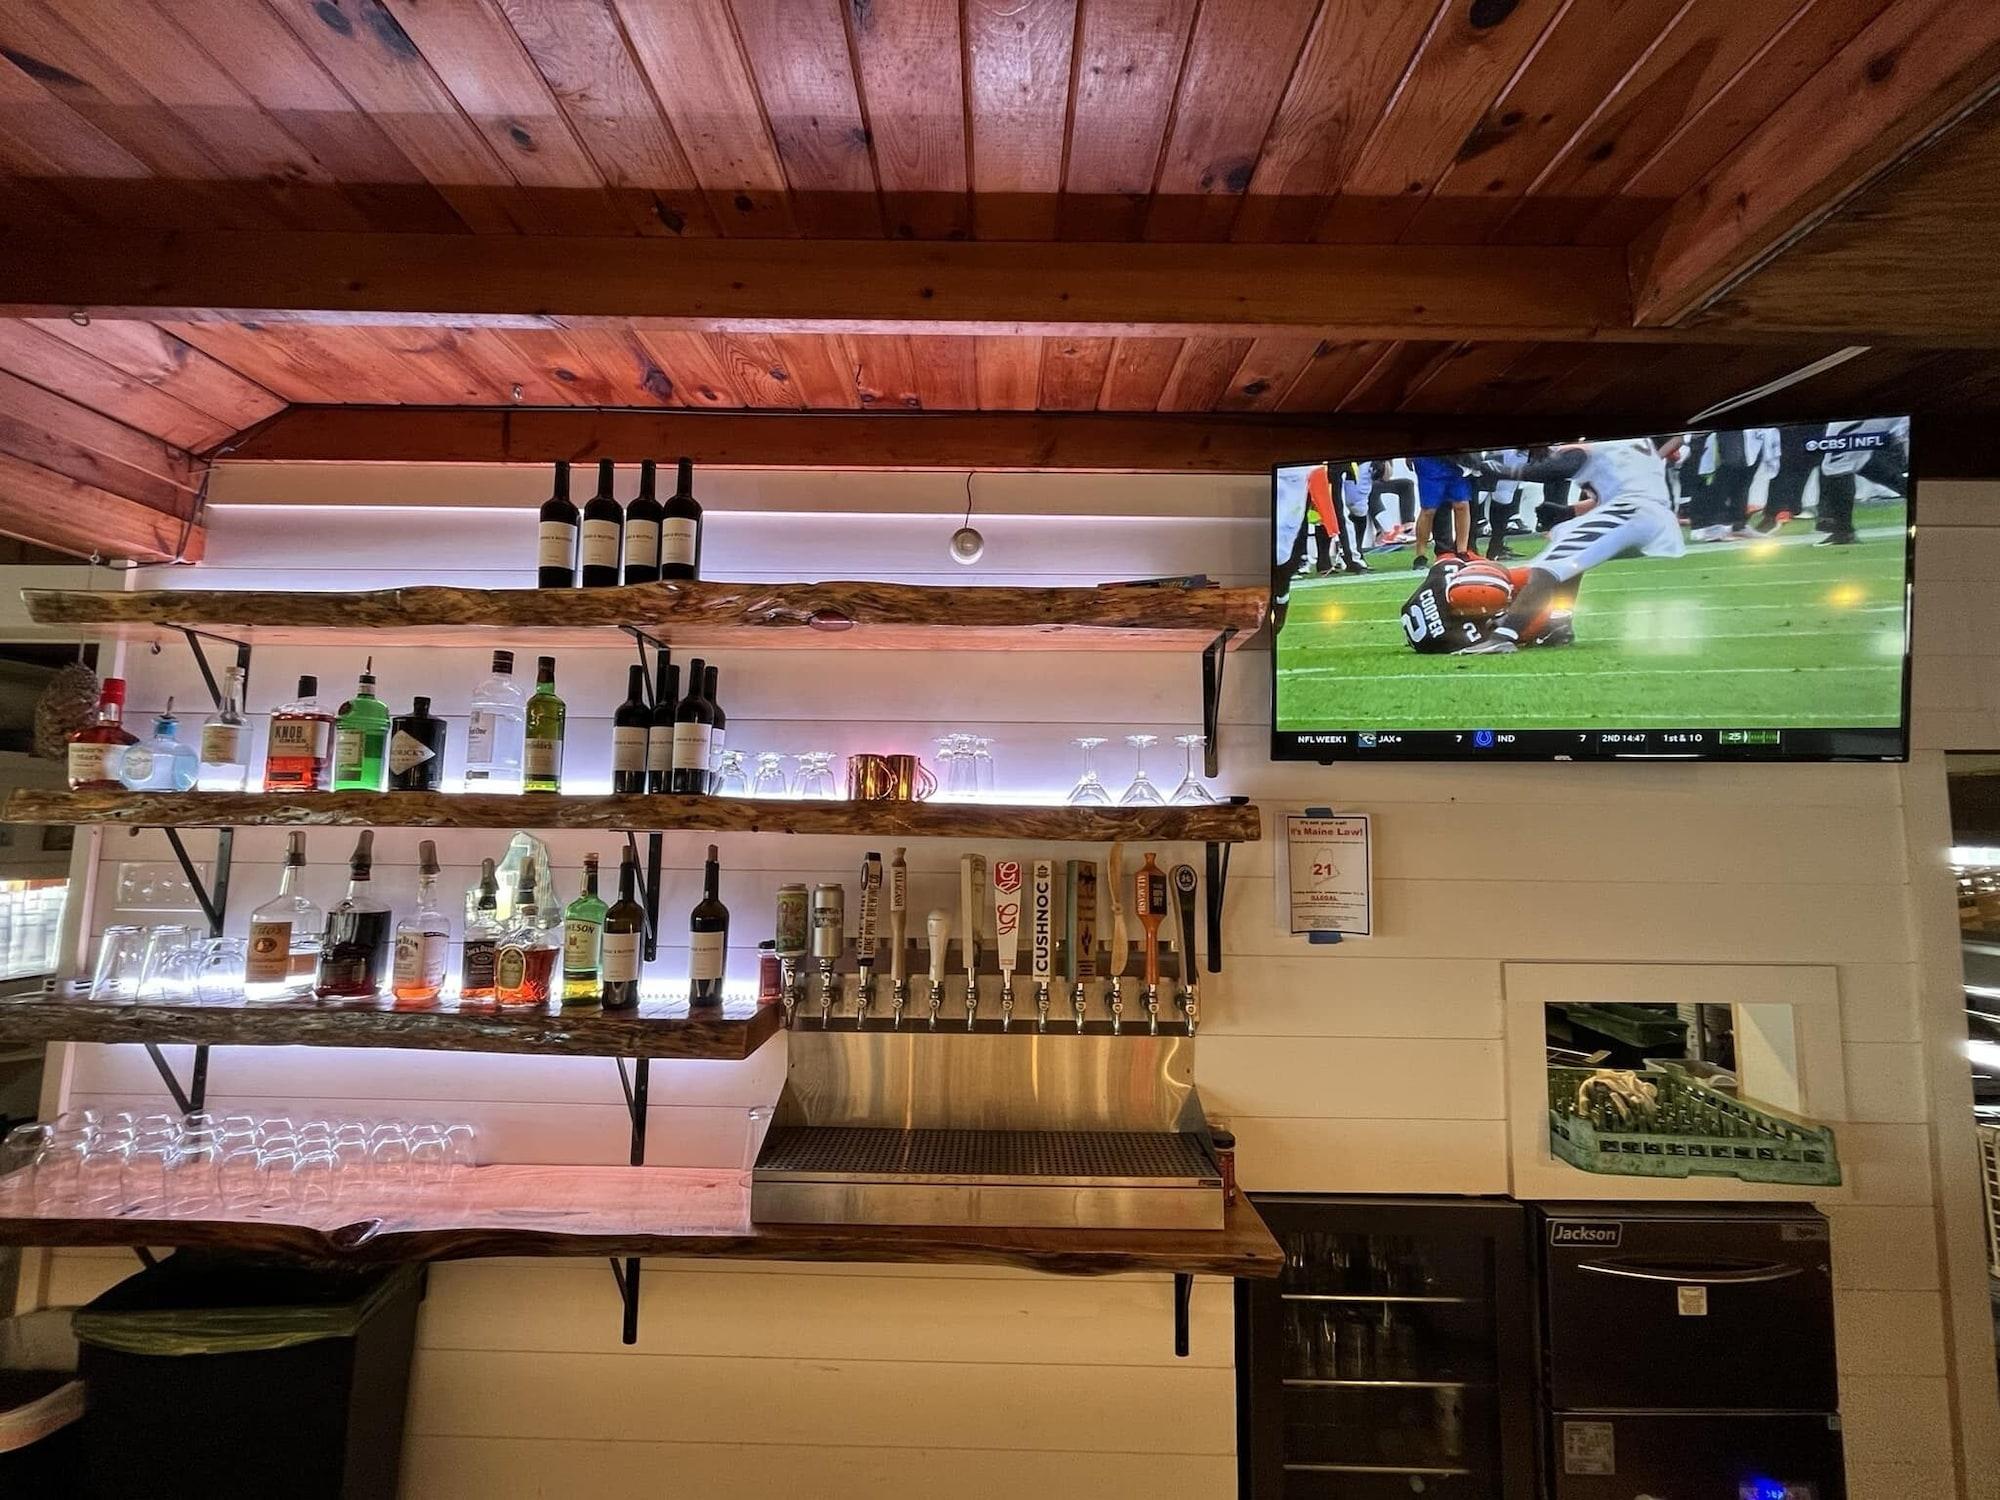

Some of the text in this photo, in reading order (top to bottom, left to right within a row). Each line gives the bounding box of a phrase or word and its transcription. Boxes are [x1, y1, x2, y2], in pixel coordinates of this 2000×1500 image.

[1818, 435, 1884, 451] CBS NFL
[1419, 588, 1446, 639] COOPER
[1462, 622, 1482, 643] 2
[274, 725, 304, 739] KNOB
[1728, 732, 1742, 741] 25
[1298, 735, 1315, 744] NFL
[1316, 735, 1342, 744] WEEK
[1378, 735, 1396, 744] JAX
[1456, 735, 1463, 743] 7
[1497, 735, 1516, 743] IND
[1579, 735, 1587, 743] 7
[1602, 734, 1646, 743] 2ND 14:47
[1663, 734, 1678, 743] 1st
[1689, 734, 1703, 743] 10
[1303, 827, 1334, 836] Maine
[1337, 827, 1364, 837] Law!
[1313, 863, 1333, 876] 21
[1036, 881, 1049, 972] CUSHNOC
[1554, 1226, 1617, 1242] Jackson
